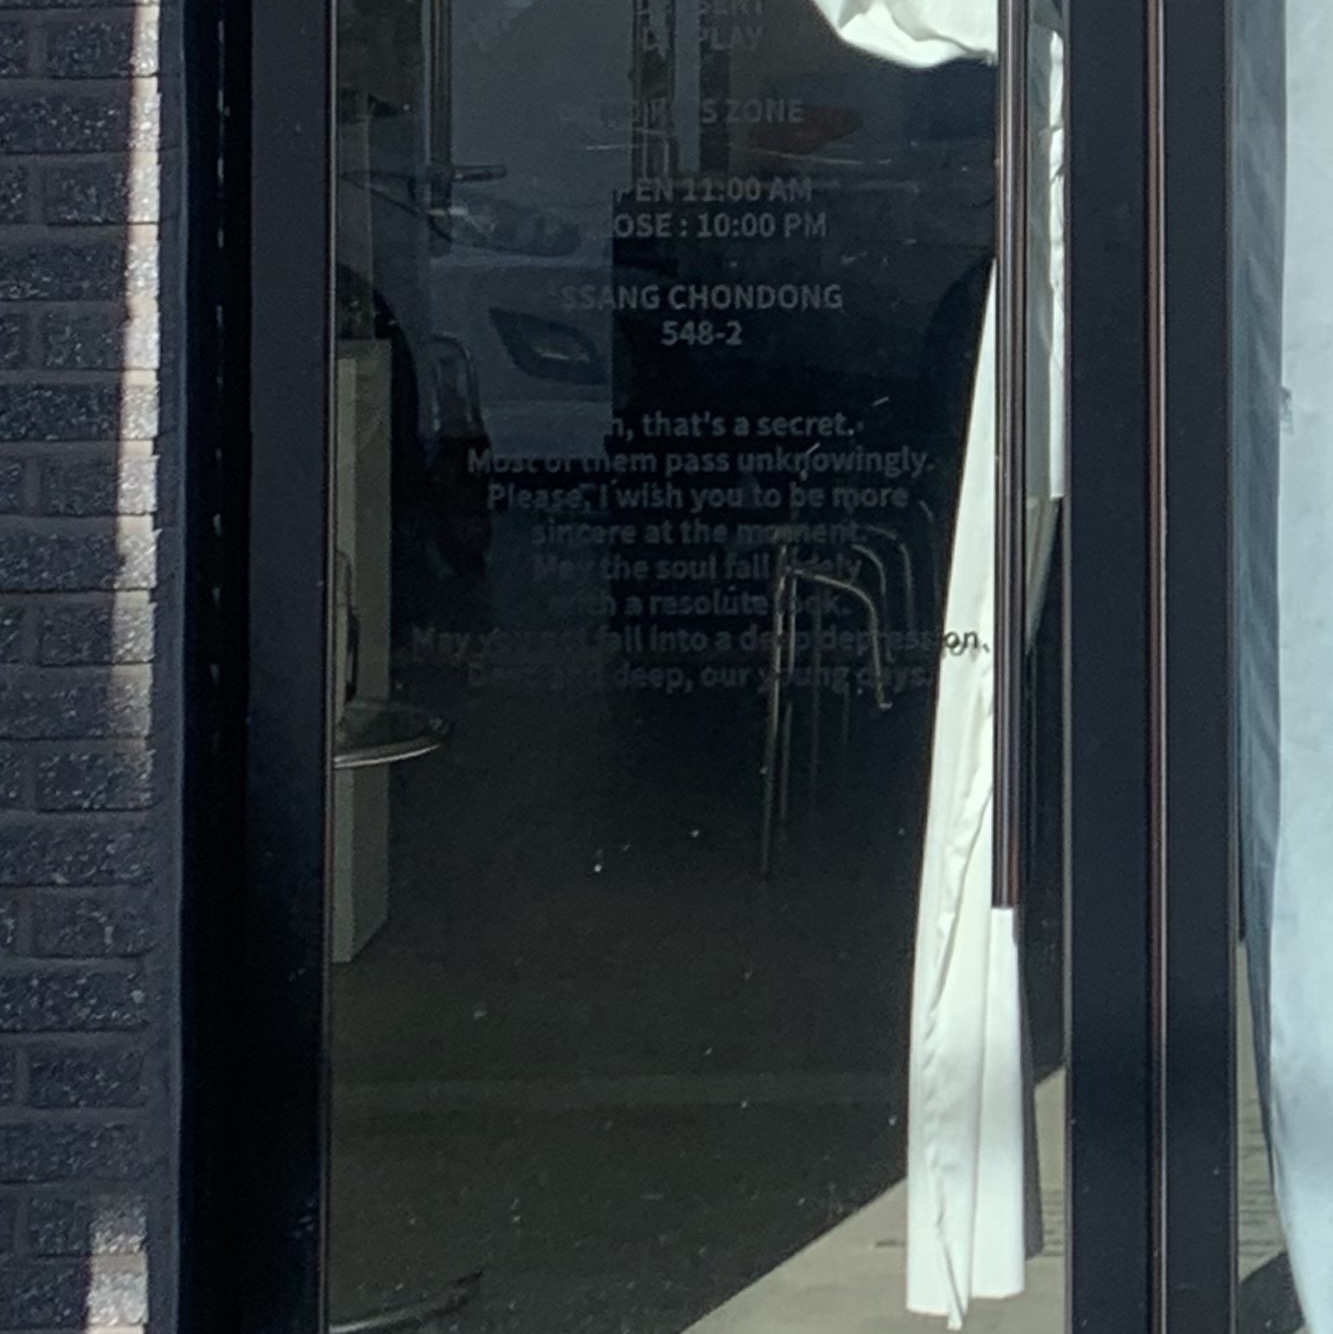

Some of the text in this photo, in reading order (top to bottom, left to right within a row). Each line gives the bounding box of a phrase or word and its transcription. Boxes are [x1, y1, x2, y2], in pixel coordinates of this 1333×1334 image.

[725, 98, 805, 123] ZONE
[682, 178, 760, 202] 11:00
[768, 178, 813, 202] AM
[697, 212, 776, 237] 10:00
[784, 212, 828, 237] PM
[559, 284, 843, 310] SSANG CHONDONG
[661, 319, 743, 346] 548-2
[642, 411, 725, 437] that's
[734, 418, 749, 437] a
[757, 412, 855, 437] secret.
[665, 452, 730, 477] pass
[616, 482, 683, 508] wish
[690, 487, 742, 513] you
[753, 485, 781, 508] to
[791, 482, 824, 508] be
[832, 488, 909, 508] more
[532, 519, 636, 545] sincere
[645, 522, 674, 545] at
[680, 519, 727, 545] the
[600, 553, 649, 581] the
[655, 554, 716, 581] soul
[725, 553, 770, 581] fall
[624, 595, 643, 615] a
[649, 586, 769, 615] resolute
[650, 625, 708, 652] into
[715, 630, 731, 652] a
[613, 660, 694, 695] deep,
[702, 666, 749, 686] our
